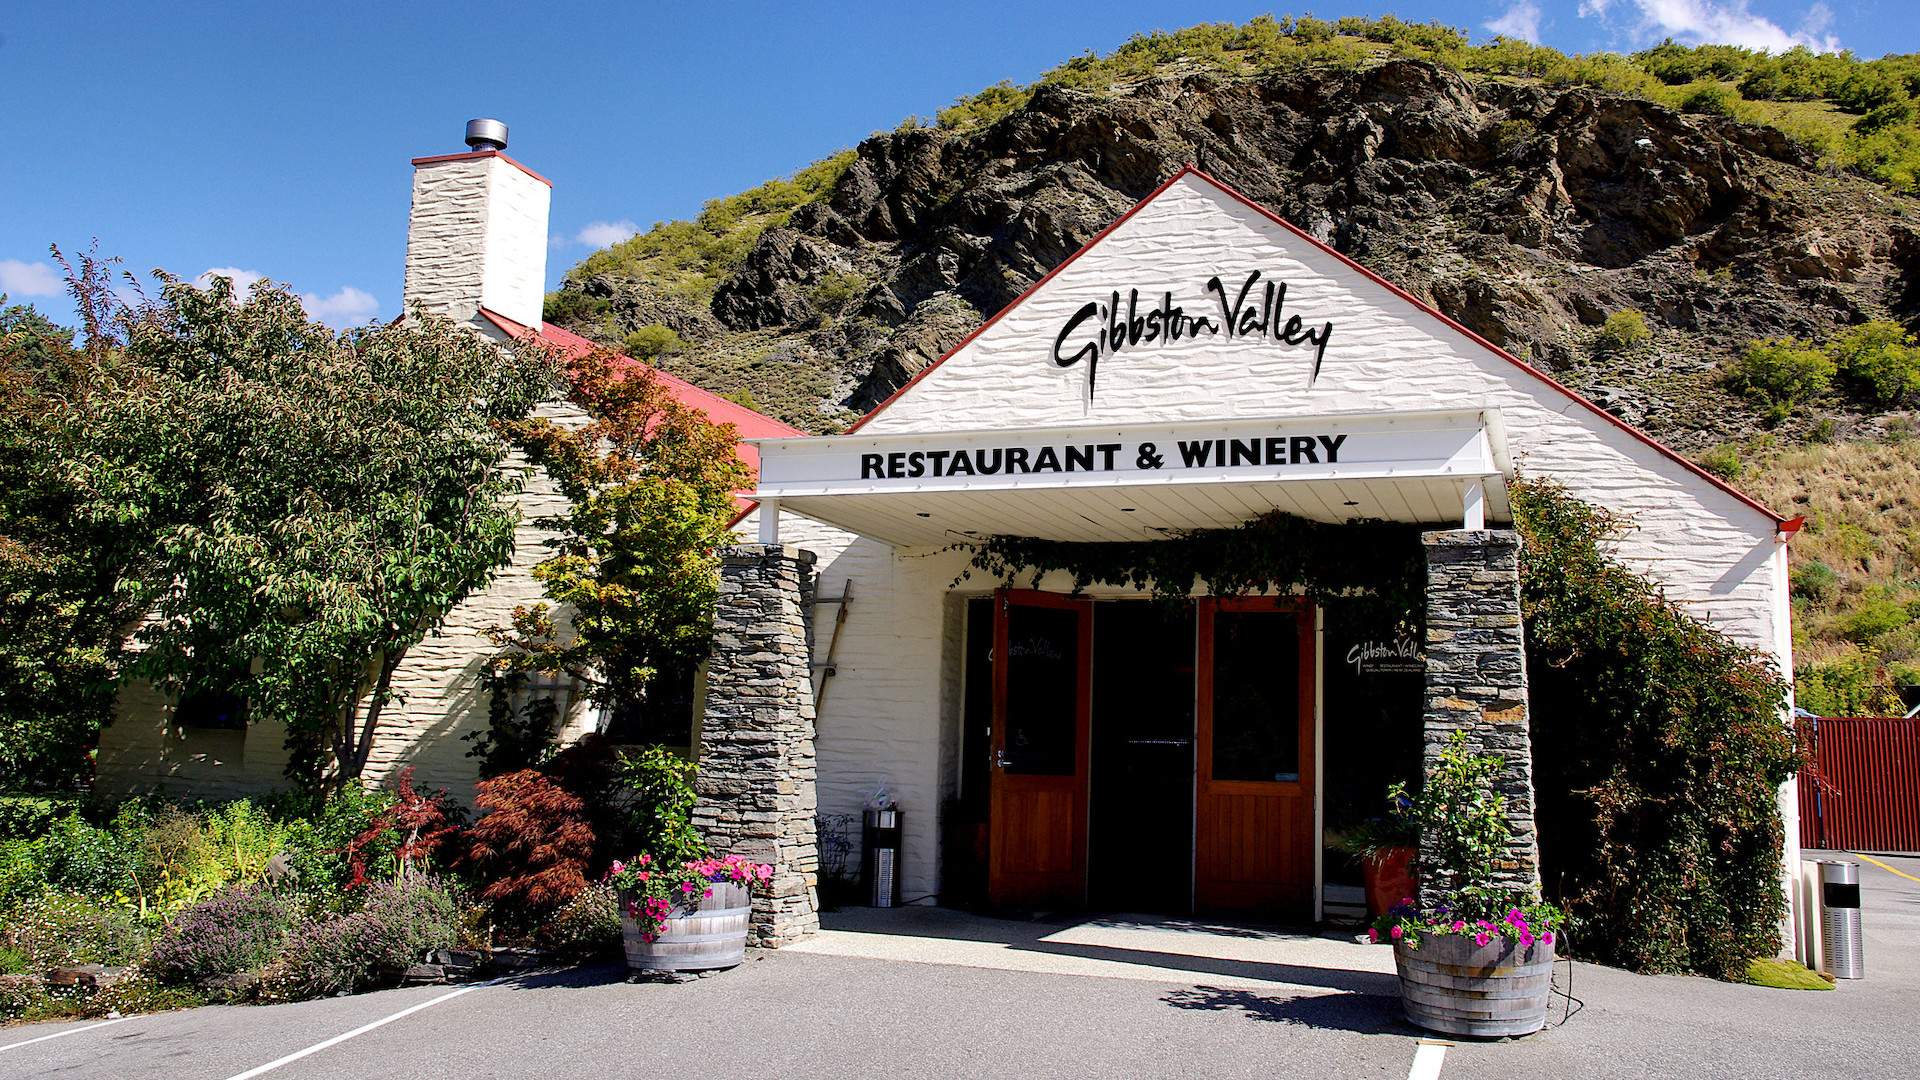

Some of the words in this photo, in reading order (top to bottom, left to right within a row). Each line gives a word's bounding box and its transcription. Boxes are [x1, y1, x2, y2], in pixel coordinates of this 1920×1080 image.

[1054, 288, 1219, 409] Gibbston
[1207, 269, 1333, 383] Valley
[861, 443, 1121, 479] RESTAURANT
[1136, 442, 1164, 469] &
[1177, 434, 1348, 468] WINERY
[1346, 640, 1397, 676] Gibbston
